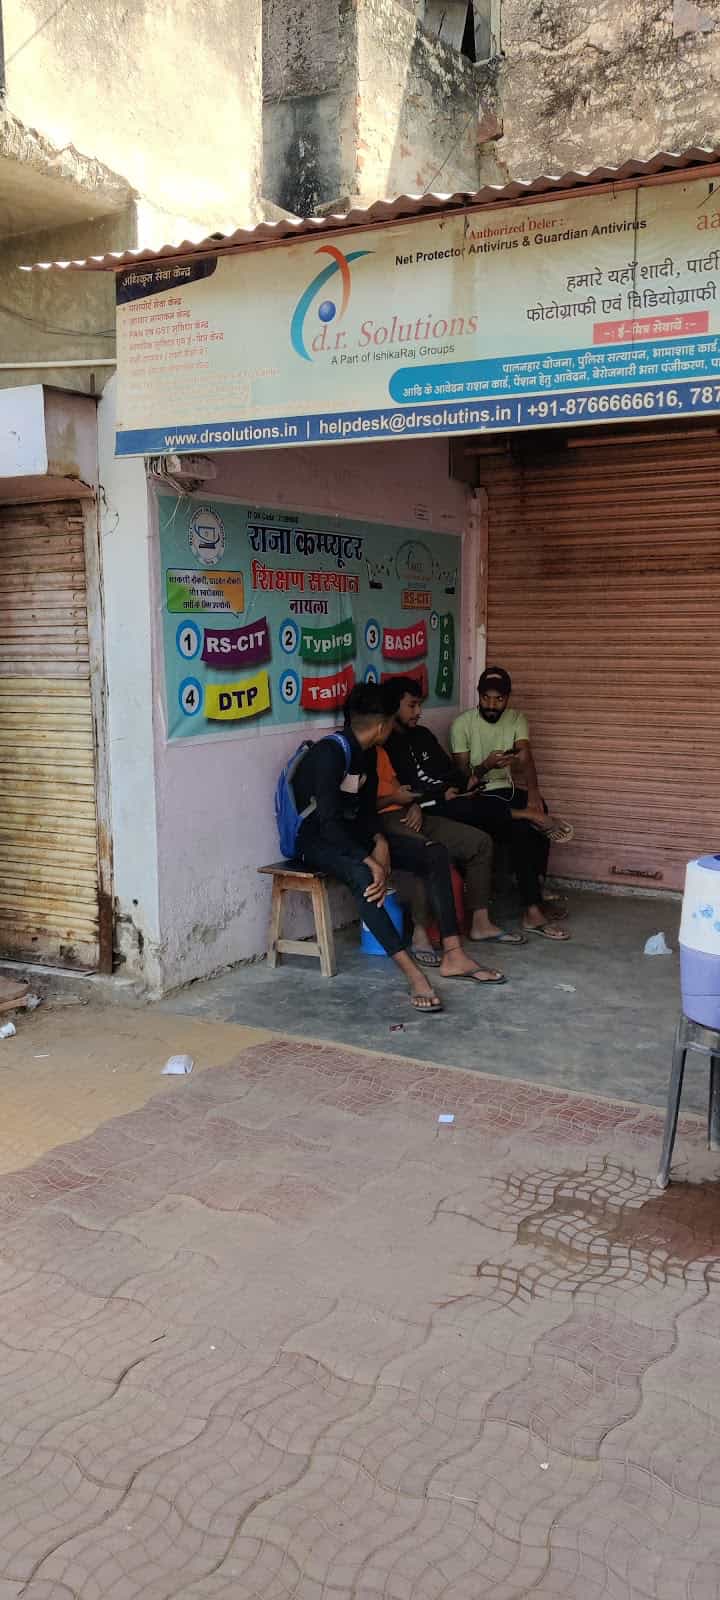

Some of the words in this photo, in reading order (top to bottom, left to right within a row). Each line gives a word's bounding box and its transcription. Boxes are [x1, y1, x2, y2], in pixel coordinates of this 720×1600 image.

[468, 223, 525, 240] Authorized
[528, 217, 555, 231] Deler
[395, 254, 413, 266] Net
[416, 246, 465, 262] Protector
[468, 238, 518, 254] Antivirus
[522, 236, 531, 246] &
[534, 227, 588, 245] Guardian
[591, 219, 648, 236] Antivirus
[155, 268, 171, 282] सेवा
[566, 266, 602, 292] हमारे
[607, 261, 637, 285] यहाँ
[640, 257, 681, 279] शादी,
[527, 296, 597, 321] फोटोग्राफी
[601, 294, 622, 314] एवं
[628, 280, 717, 310] विडियोग्राफी
[312, 324, 347, 352] d.r.
[358, 314, 478, 347] Solutions
[331, 356, 338, 365] A
[340, 354, 358, 366] Part
[361, 352, 370, 362] of
[373, 347, 416, 361] IshikaRaj
[419, 343, 455, 357] Groups
[578, 352, 604, 369] पुलिस
[403, 384, 422, 397] आदि
[424, 382, 432, 394] के
[164, 423, 298, 447] www.drsolutions.in
[319, 404, 511, 436] helpdesk@drsolutins.in
[527, 390, 683, 418] +91-8766666616,
[247, 525, 293, 554] राजा
[251, 559, 305, 592] शिक्षण
[289, 598, 329, 615] नायला
[184, 633, 191, 651] 1
[206, 630, 266, 653] RS-CIT
[285, 630, 293, 646] 2
[303, 632, 353, 653] Typing
[369, 629, 376, 644] 3
[384, 630, 424, 651] BASIC
[185, 689, 195, 706] 4
[219, 686, 258, 711] DTP
[285, 681, 293, 697] 5
[308, 681, 349, 701] Tally
